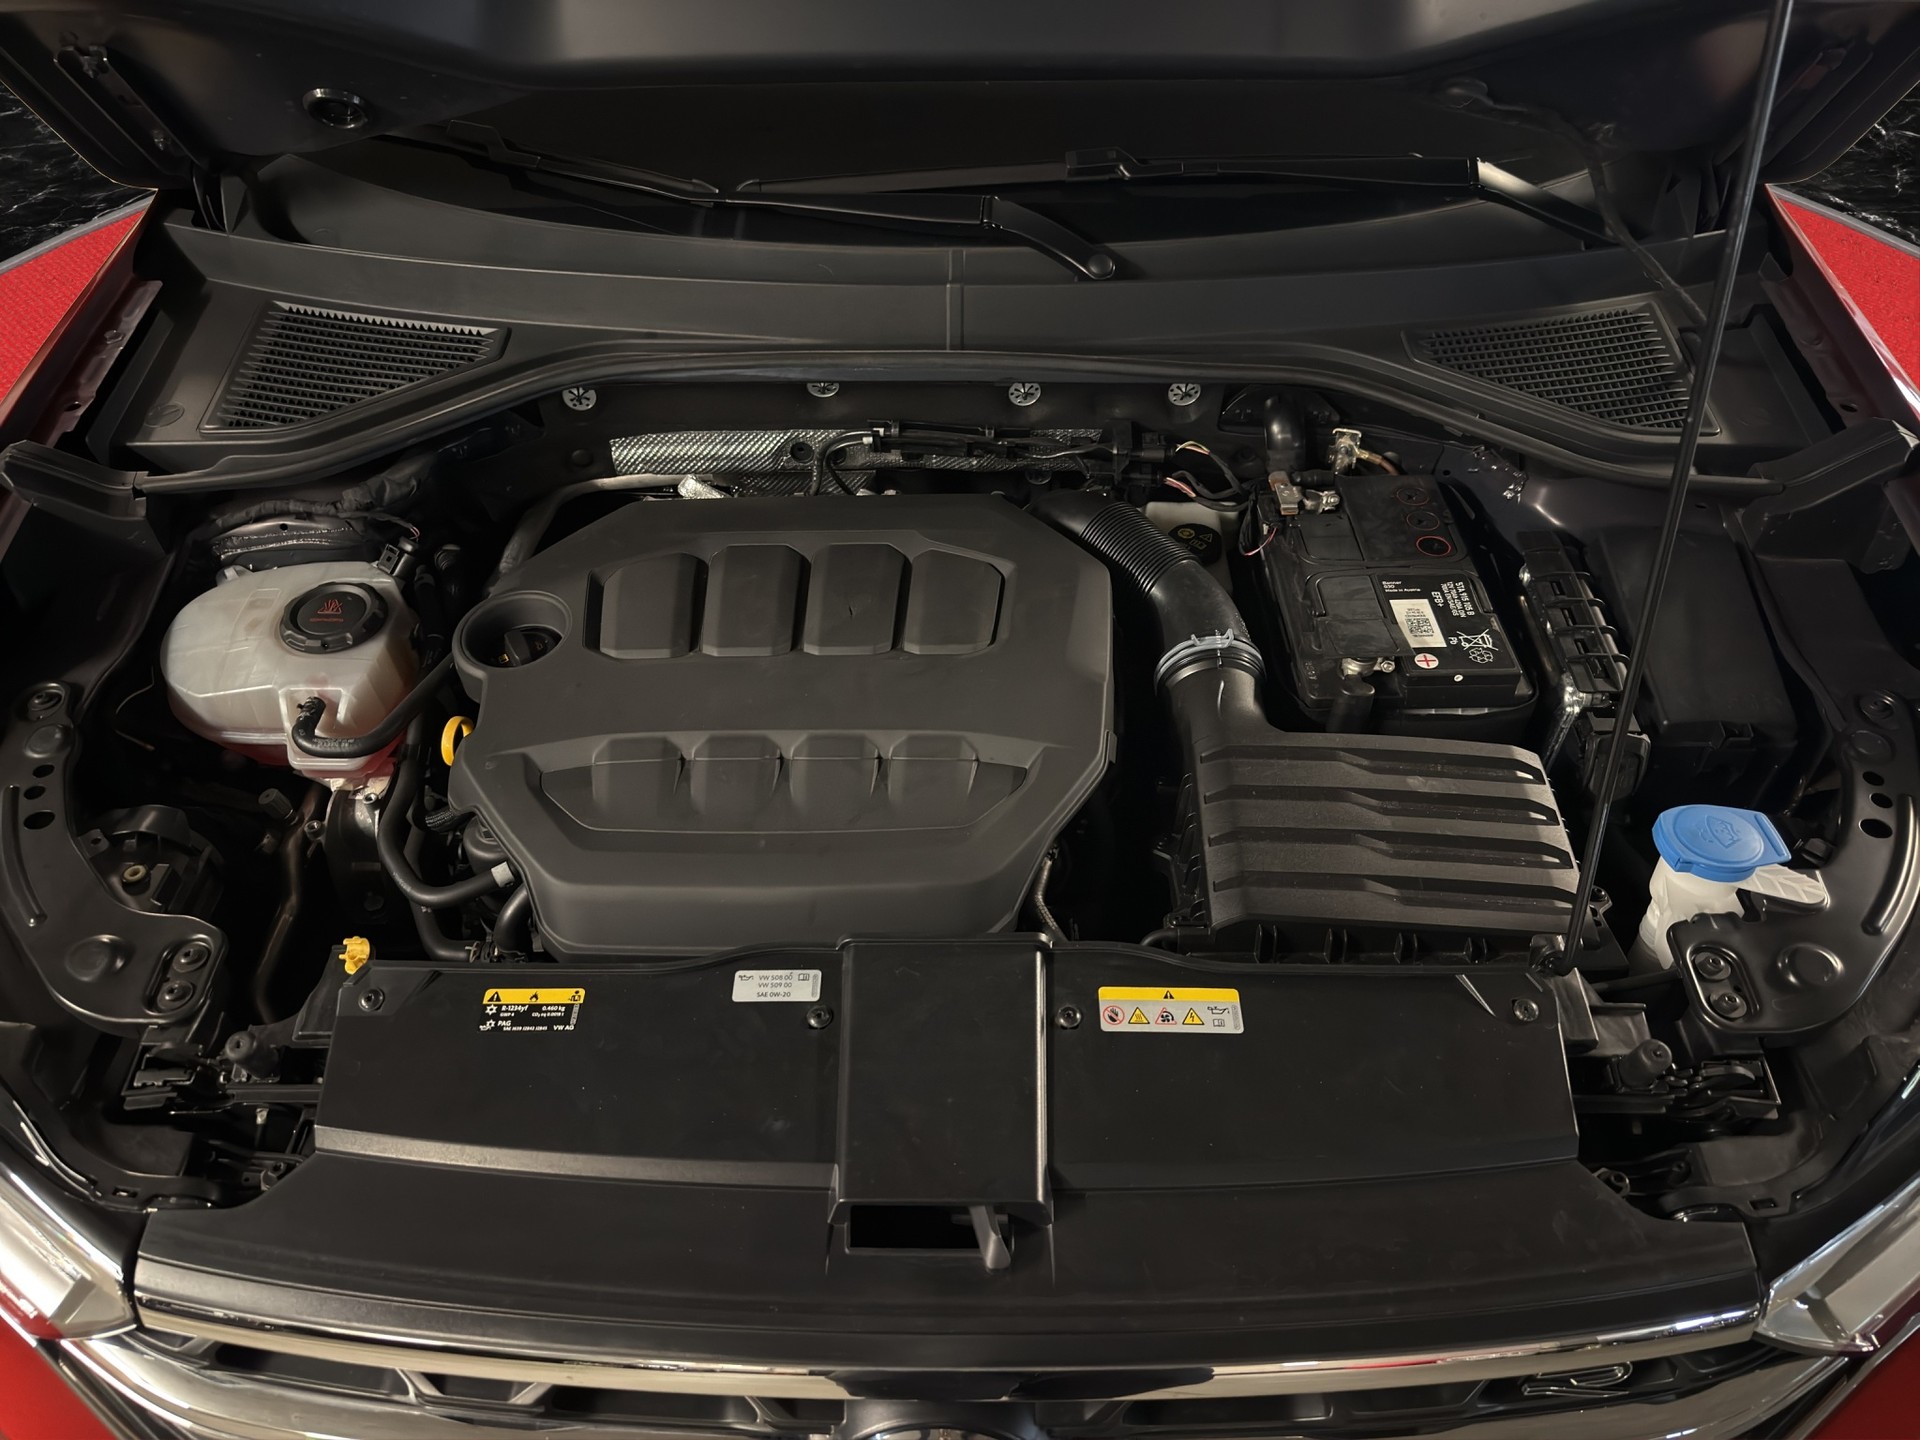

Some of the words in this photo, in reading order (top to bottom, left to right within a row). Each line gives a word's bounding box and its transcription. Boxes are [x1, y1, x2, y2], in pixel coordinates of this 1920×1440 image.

[1431, 591, 1445, 608] EFB+
[1459, 592, 1470, 602] 915
[1458, 610, 1467, 618] DIN
[1448, 636, 1458, 645] Pb
[501, 1005, 529, 1013] R-1234yf
